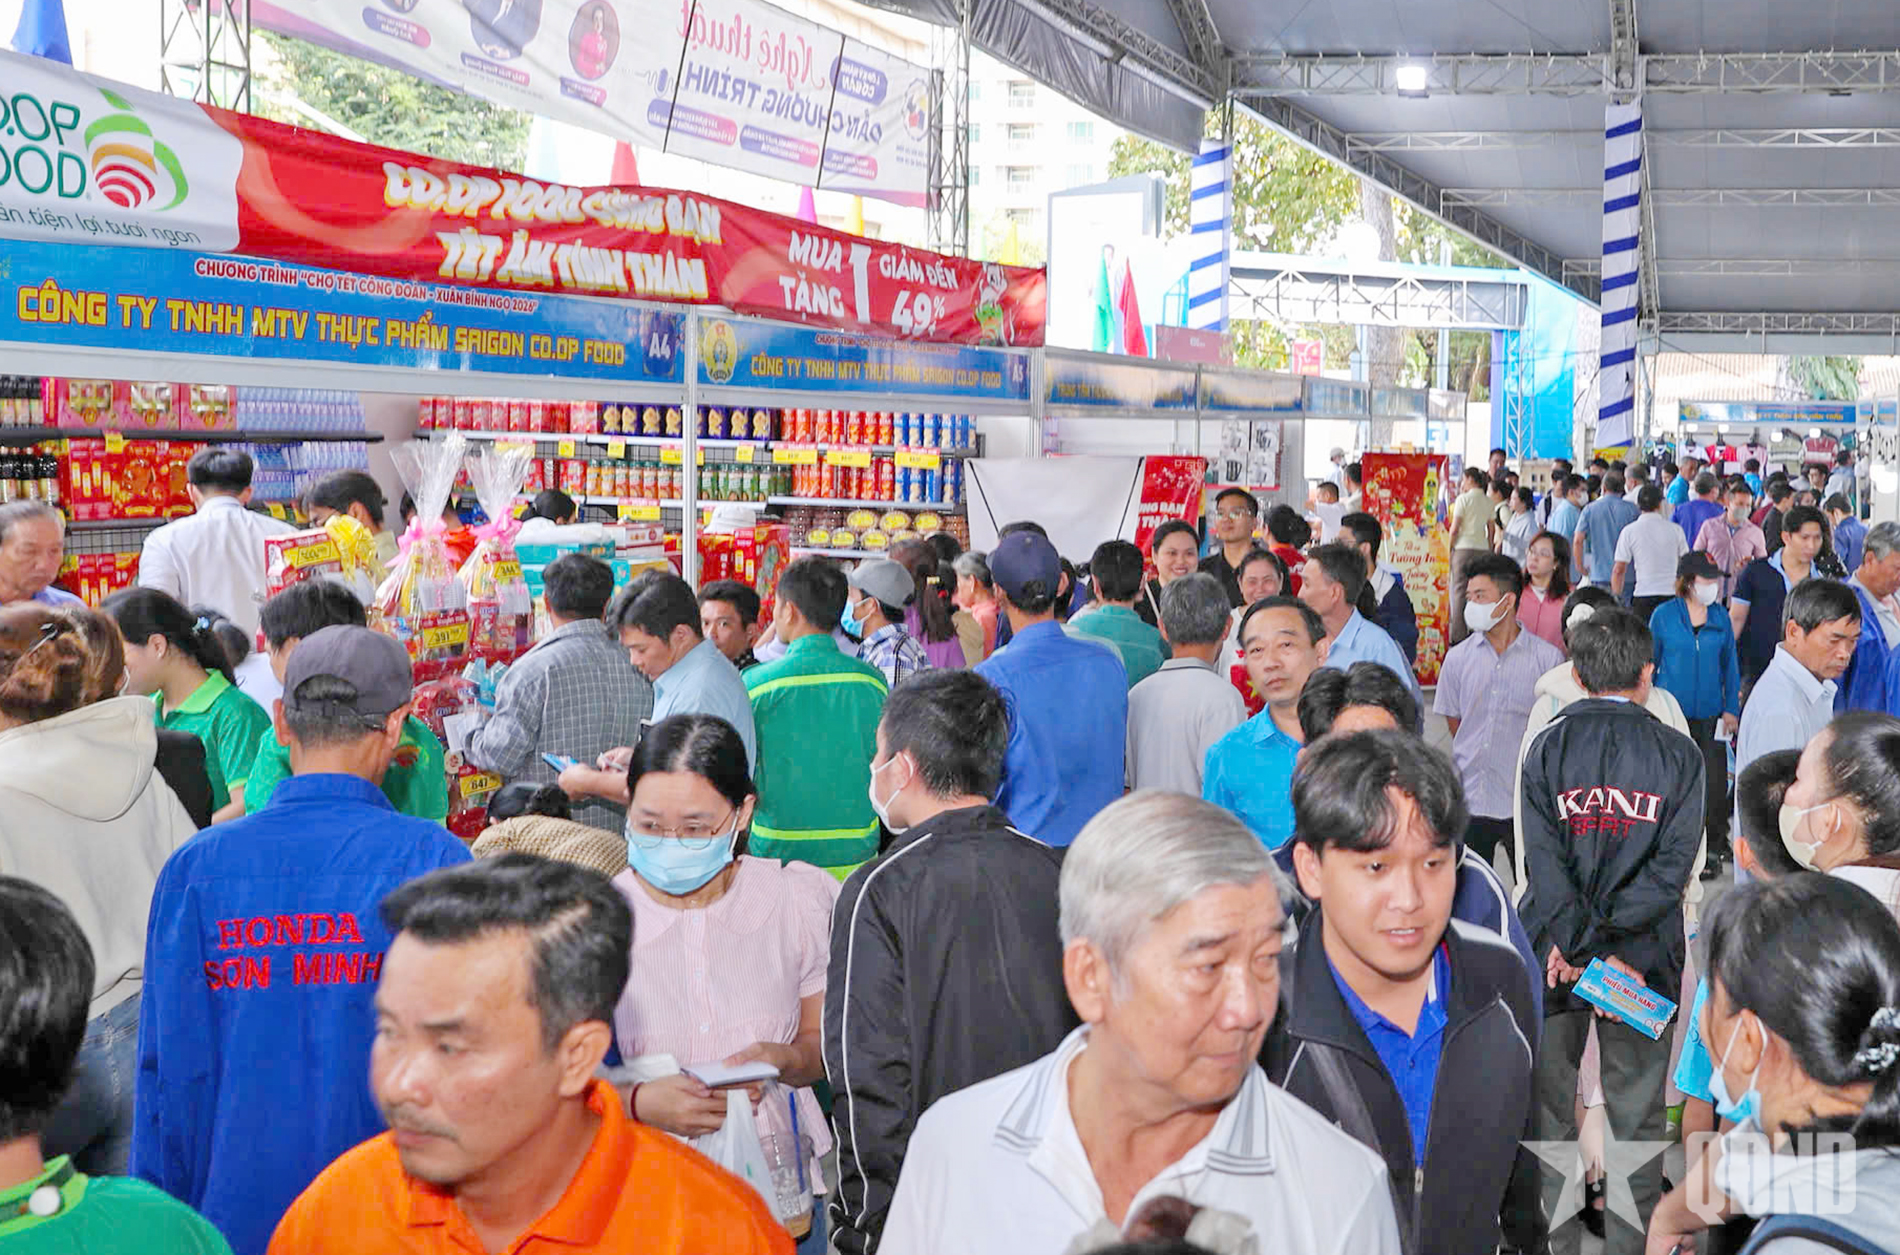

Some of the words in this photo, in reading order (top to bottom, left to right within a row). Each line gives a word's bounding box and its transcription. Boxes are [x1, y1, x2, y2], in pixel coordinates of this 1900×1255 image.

[152, 227, 201, 247] ngon
[666, 194, 722, 246] BẠN
[436, 226, 504, 281] TẾT
[625, 250, 709, 299] THÂN
[788, 230, 842, 272] MUA
[879, 249, 925, 284] GIẢM
[925, 258, 959, 290] ĐẾN
[195, 259, 258, 281] CHƯƠNG
[259, 263, 298, 285] TRÌNH
[336, 273, 357, 292] TẾT
[358, 275, 393, 296] CÔNG
[394, 280, 427, 300] ĐOÀN
[435, 286, 464, 304] XUÂN
[464, 289, 487, 308] BÍNH
[488, 295, 512, 315] NGỌ
[778, 271, 845, 321] TẶNG
[848, 242, 872, 324] 1
[17, 277, 108, 327] CÔNG
[117, 295, 157, 329] TY
[166, 299, 244, 336] TNHH
[252, 306, 310, 340] MTV
[315, 311, 380, 350] THỰC
[385, 310, 450, 352] PHẨM
[454, 326, 524, 358] SAIGON
[529, 333, 580, 362] CO.OP
[583, 339, 626, 367] FOOD
[649, 330, 672, 361] A4
[750, 351, 783, 376] CÔNG
[786, 357, 801, 378] TY
[805, 358, 835, 380] TNHH
[837, 360, 861, 381] MTV
[981, 370, 1001, 389] FOOD
[1557, 784, 1662, 824] KANI
[216, 912, 365, 950] HONDA
[204, 955, 271, 990] SƠN
[293, 952, 383, 985] MINH
[1602, 976, 1622, 991] PHIẾU
[1622, 987, 1638, 1001] MUA
